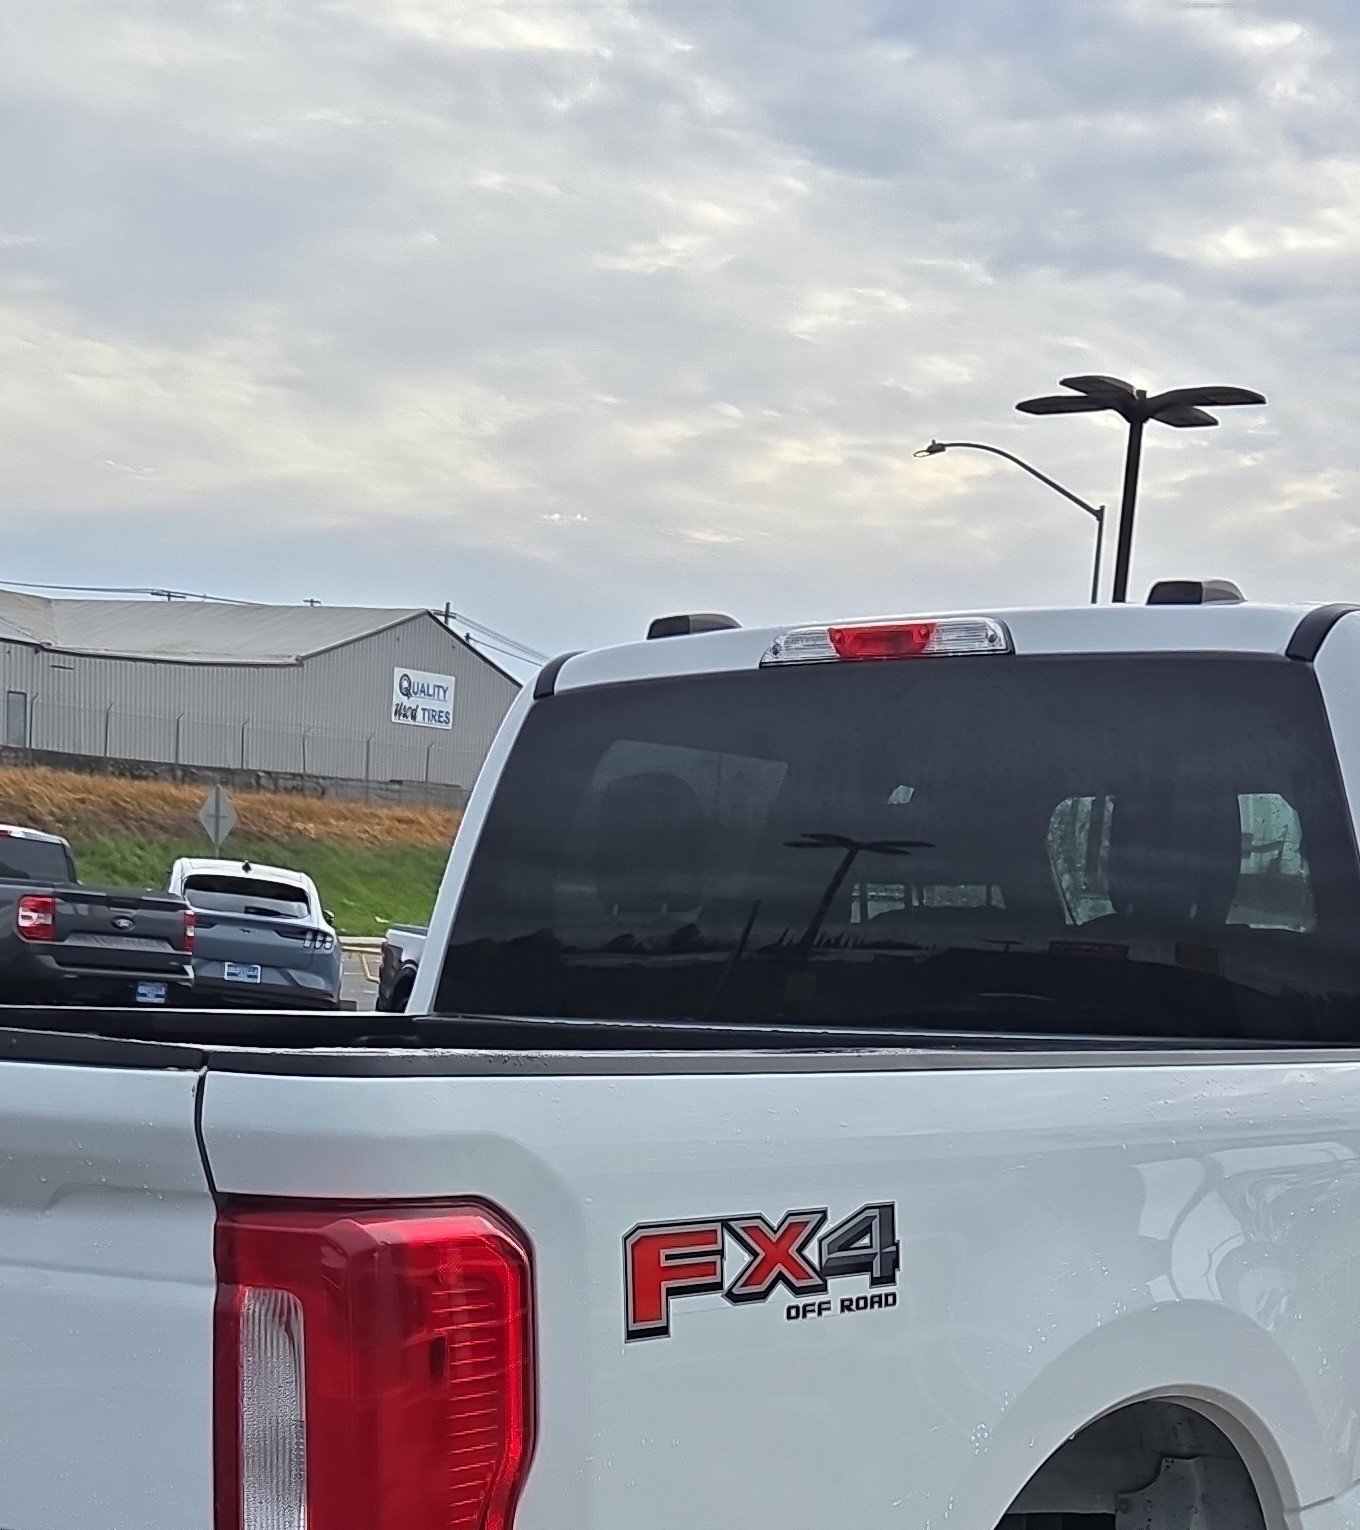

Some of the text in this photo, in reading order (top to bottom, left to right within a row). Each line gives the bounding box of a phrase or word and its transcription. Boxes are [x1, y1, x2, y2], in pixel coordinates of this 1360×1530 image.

[398, 673, 449, 700] QUALITY
[420, 707, 451, 725] TIRES
[622, 1201, 900, 1344] FX4
[786, 1292, 897, 1321] OFF ROAD
